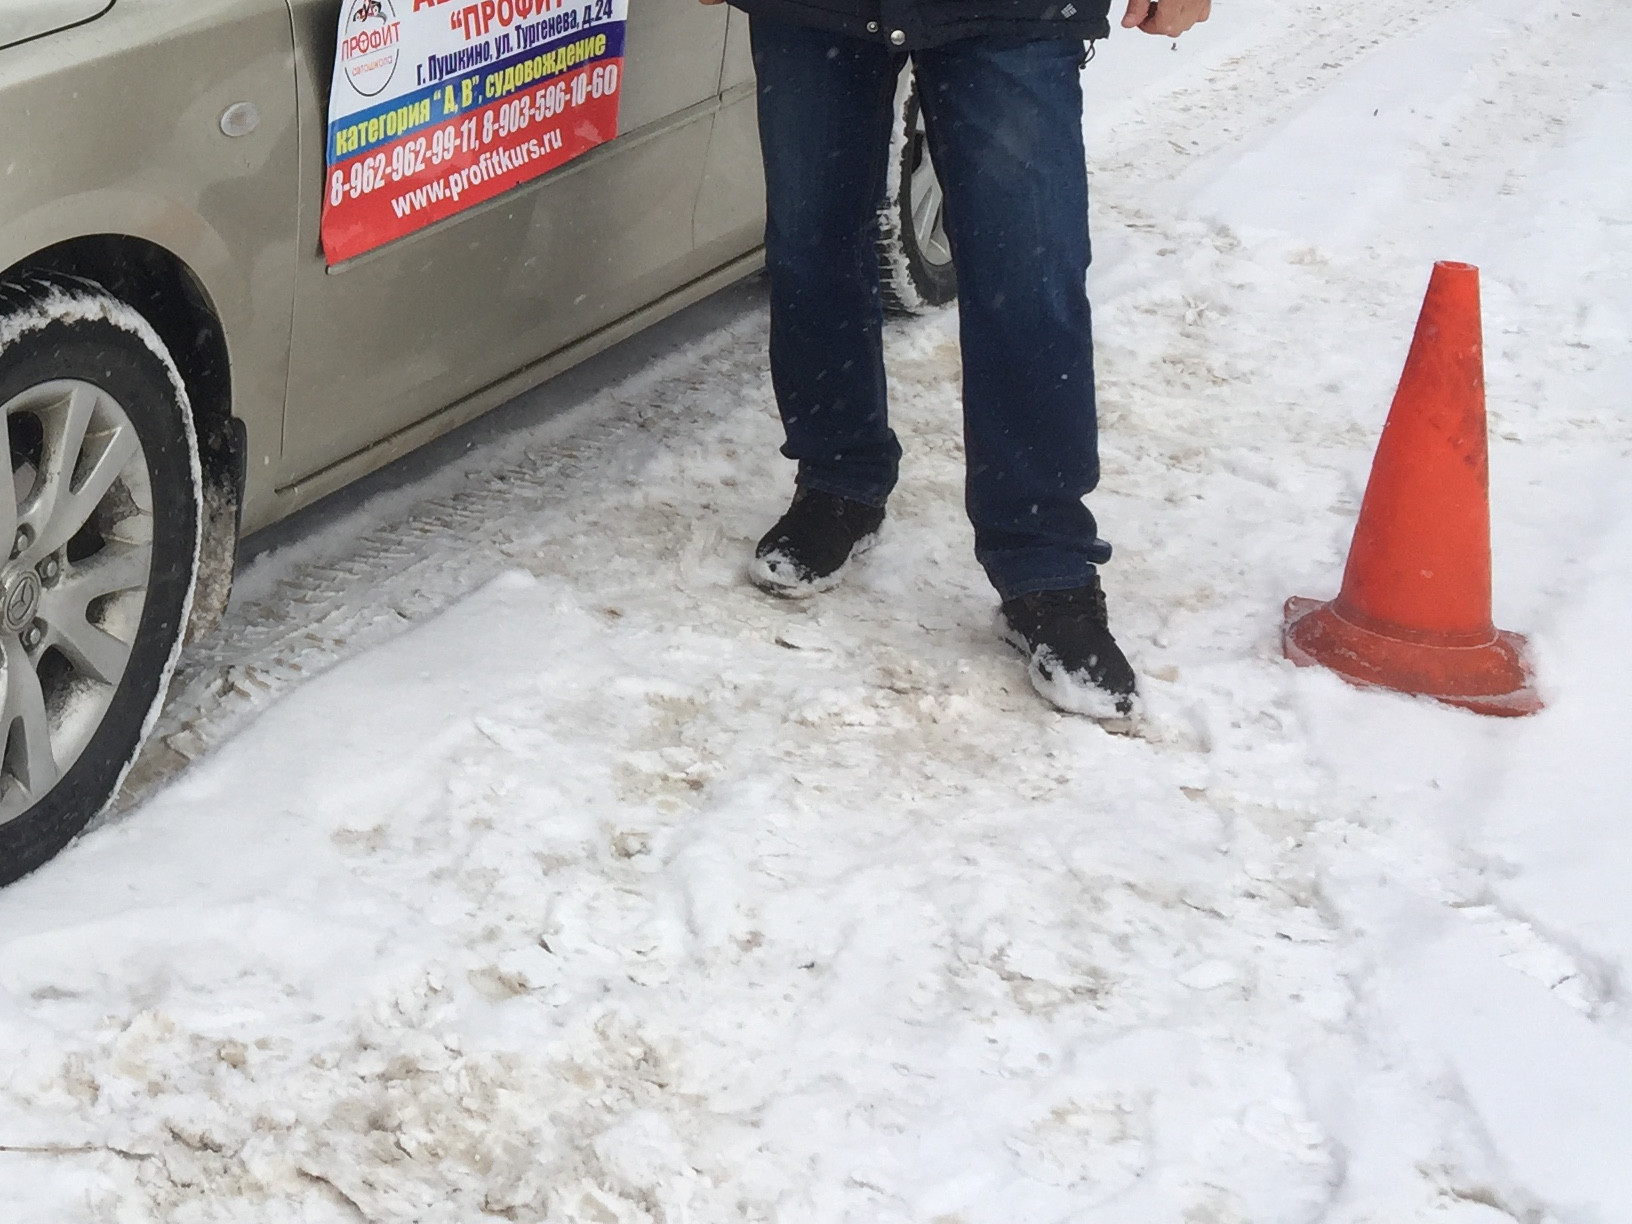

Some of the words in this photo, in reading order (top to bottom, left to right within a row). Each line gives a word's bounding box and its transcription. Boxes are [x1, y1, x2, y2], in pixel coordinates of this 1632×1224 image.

[341, 21, 401, 61] ПРОФИТ
[417, 64, 426, 86] г.
[428, 37, 493, 81] Пушкино,
[494, 32, 513, 59] ул.
[515, 8, 580, 50] Тургенева,
[330, 119, 479, 207] 8-962-962-99-11,
[482, 63, 618, 144] 8-903-596-10-60
[335, 101, 430, 157] категория
[485, 33, 606, 99] судовождение
[391, 128, 563, 219] www.profitkurs.ru
